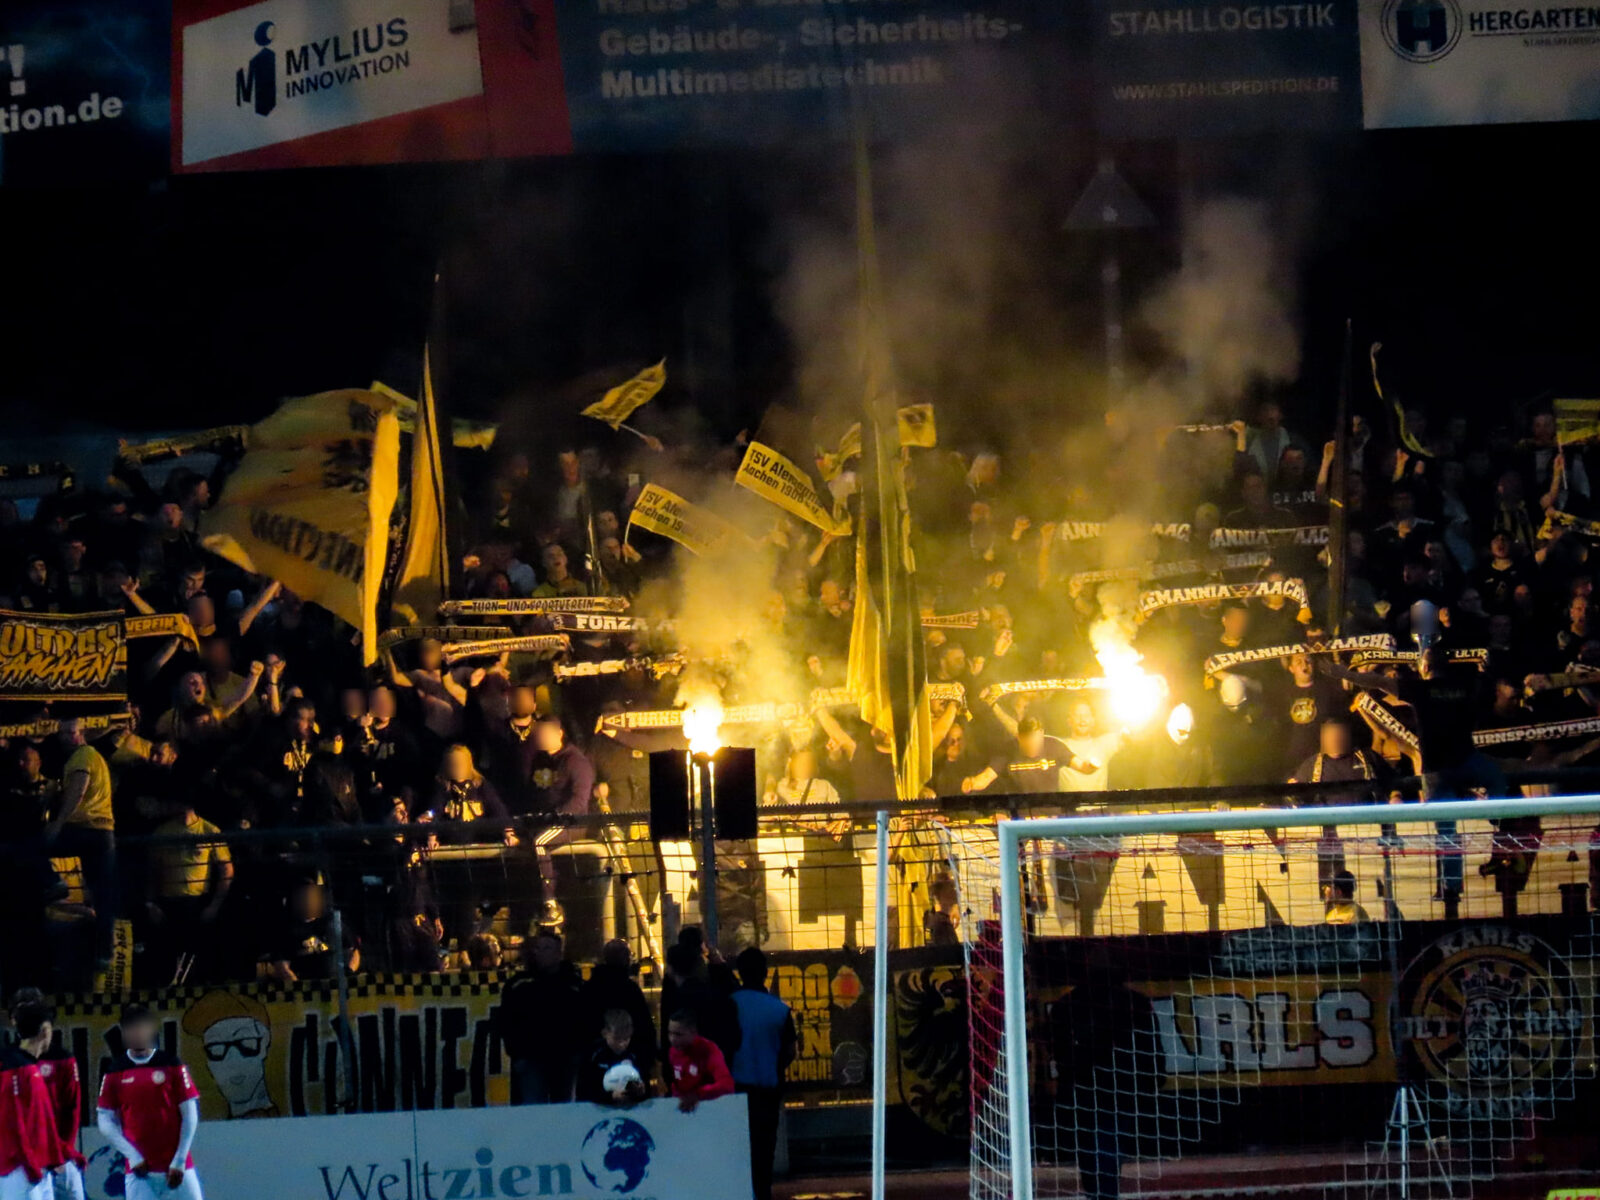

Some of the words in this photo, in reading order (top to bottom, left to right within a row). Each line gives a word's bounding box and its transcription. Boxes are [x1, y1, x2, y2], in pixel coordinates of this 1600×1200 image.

[285, 18, 410, 76] MYLIUS
[285, 50, 411, 99] INNOVATION
[601, 56, 947, 99] Multimediatechnik
[0, 91, 124, 134] tion.de
[743, 463, 780, 491] Aachen
[750, 449, 771, 468] TSV
[643, 490, 663, 506] TSV
[0, 622, 119, 656] ULTRAS
[318, 1146, 573, 1200] Weltzien
